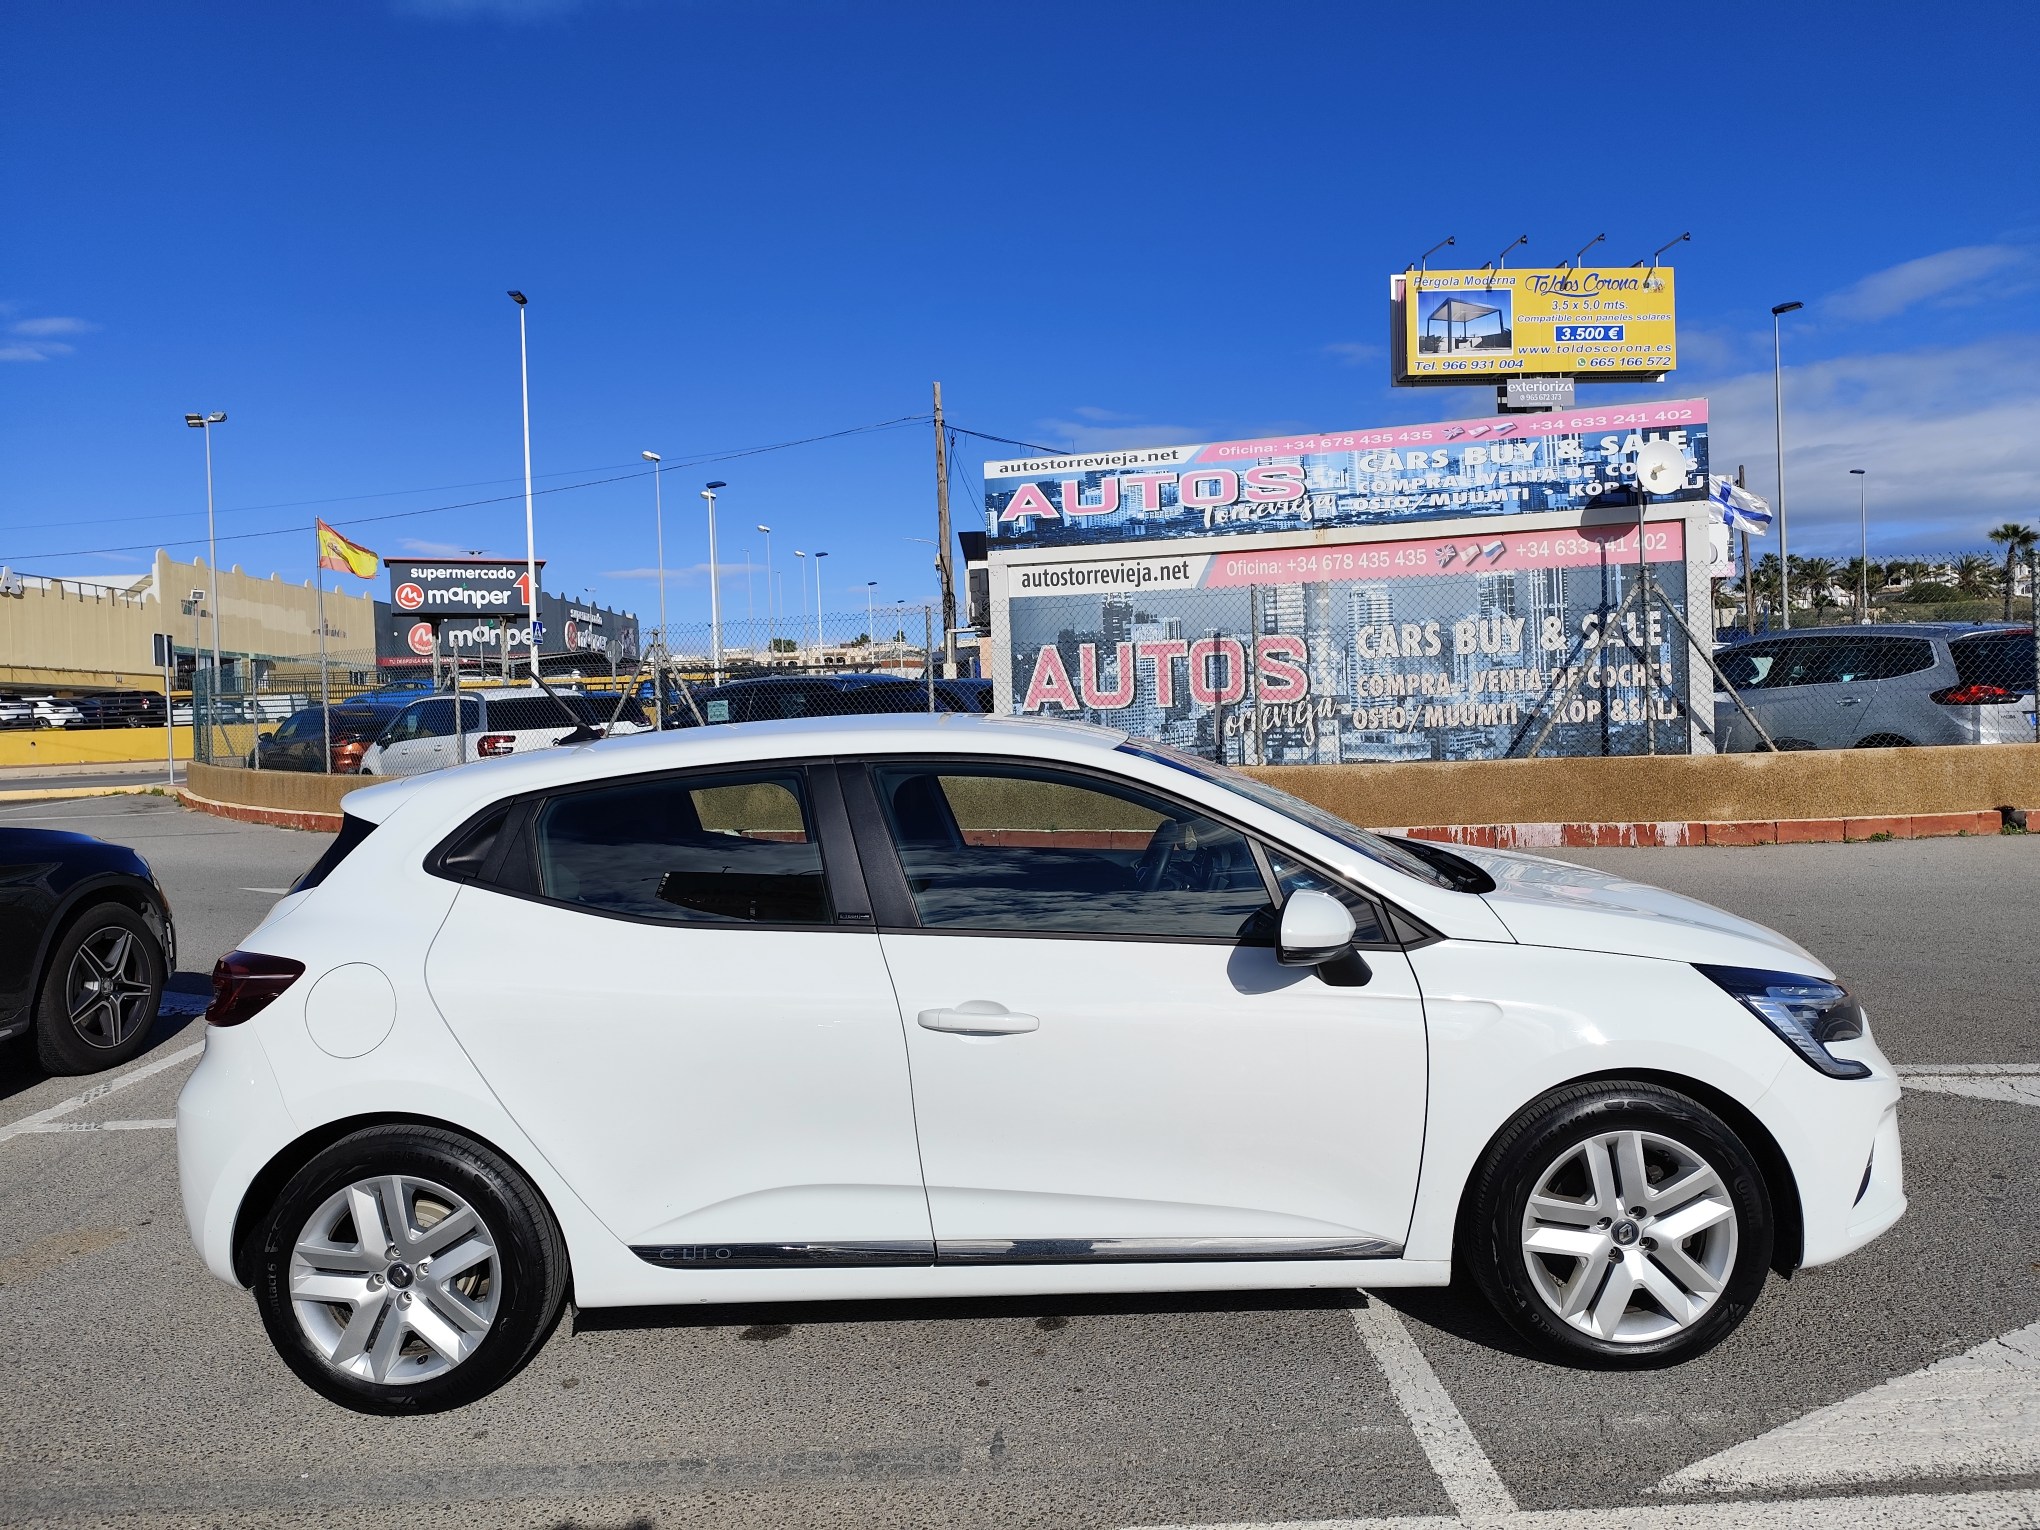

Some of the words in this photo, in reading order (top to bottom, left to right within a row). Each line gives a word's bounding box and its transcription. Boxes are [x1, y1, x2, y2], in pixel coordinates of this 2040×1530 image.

[1464, 276, 1516, 286] Moderna
[1525, 273, 1580, 297] Toldos
[1583, 273, 1640, 292] Corona
[1552, 300, 1569, 311] 3,5
[1572, 302, 1578, 310] x
[1583, 300, 1600, 311] 5,0
[1604, 301, 1628, 310] mts.
[1517, 314, 1572, 323] Compatible
[1596, 314, 1633, 322] paneles
[1561, 328, 1605, 340] 3.500
[1608, 328, 1620, 340] €
[1518, 344, 1672, 354] www.toldoscorona.es
[1414, 361, 1438, 371] Tel.
[1442, 360, 1468, 370] 966
[1470, 360, 1494, 370] 931
[1499, 360, 1524, 369] 004
[1590, 358, 1615, 367] 665
[1620, 357, 1643, 366] 166
[1646, 357, 1672, 366] 572
[1508, 380, 1574, 392] exterioriza
[1218, 444, 1278, 457] Oficina:
[1283, 440, 1314, 451] +34
[1321, 436, 1354, 448] 678
[1360, 433, 1394, 445] 435
[1399, 430, 1433, 442] 435
[1528, 419, 1565, 432] +34
[1570, 416, 1607, 428] 633
[1614, 412, 1651, 424] 241
[1654, 409, 1693, 421] 402
[999, 449, 1179, 474] autostorrevieja.net
[1359, 449, 1449, 473] CARS
[1465, 441, 1541, 466] BUY
[1556, 438, 1585, 460] &
[1358, 475, 1458, 494] COMPRA
[1485, 468, 1558, 485] VENTA
[1566, 465, 1596, 479] DE
[1570, 480, 1620, 498] KÖP
[998, 464, 1308, 522] AUTOS
[1202, 492, 1336, 528] Torrevieja
[1226, 560, 1282, 577] Oficina:
[1287, 556, 1318, 572] +34
[1322, 554, 1354, 570] 678
[1358, 552, 1390, 568] 435
[1395, 549, 1427, 566] 435
[1516, 540, 1550, 558] +34
[1555, 537, 1589, 556] 633
[1594, 536, 1628, 553] 241
[410, 566, 516, 581] supermercado
[1021, 561, 1189, 588] autostorrevieja.net
[428, 586, 512, 609] manper
[1356, 622, 1442, 660] CARS
[1456, 618, 1526, 656] BUY
[1540, 616, 1568, 651] &
[1582, 611, 1662, 650] SALE
[1022, 635, 1308, 712] AUTOS
[1356, 672, 1450, 698] COMPRA
[1474, 668, 1543, 694] VENTA
[1587, 663, 1672, 689] COCHES
[1554, 694, 1601, 724] KÖP
[660, 1246, 731, 1260] CLIO
